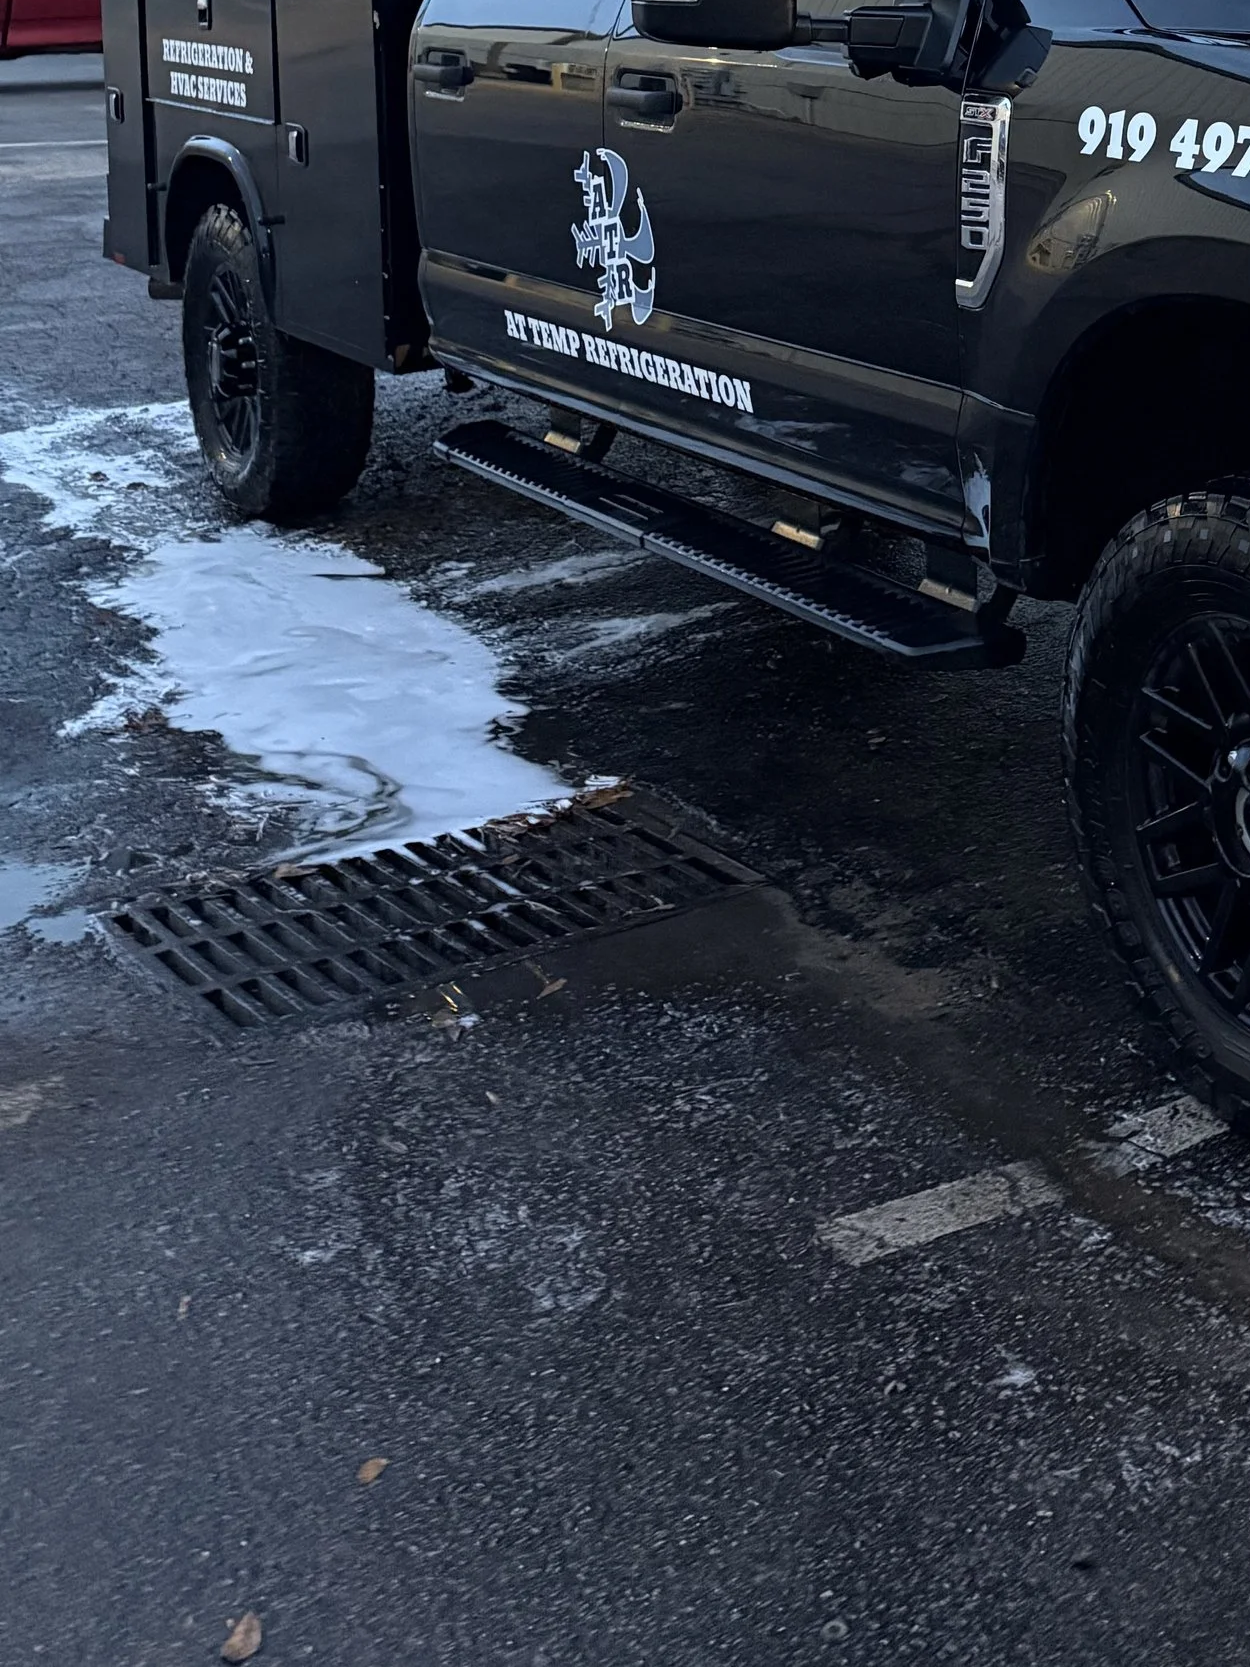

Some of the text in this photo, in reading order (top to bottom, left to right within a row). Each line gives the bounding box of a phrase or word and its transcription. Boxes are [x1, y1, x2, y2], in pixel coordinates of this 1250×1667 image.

[162, 38, 254, 75] REFRIGERATION &
[170, 71, 247, 108] HVAC SERVICES
[1077, 105, 1157, 163] 919
[503, 309, 754, 414] AT TEMP REFRIGERATION
